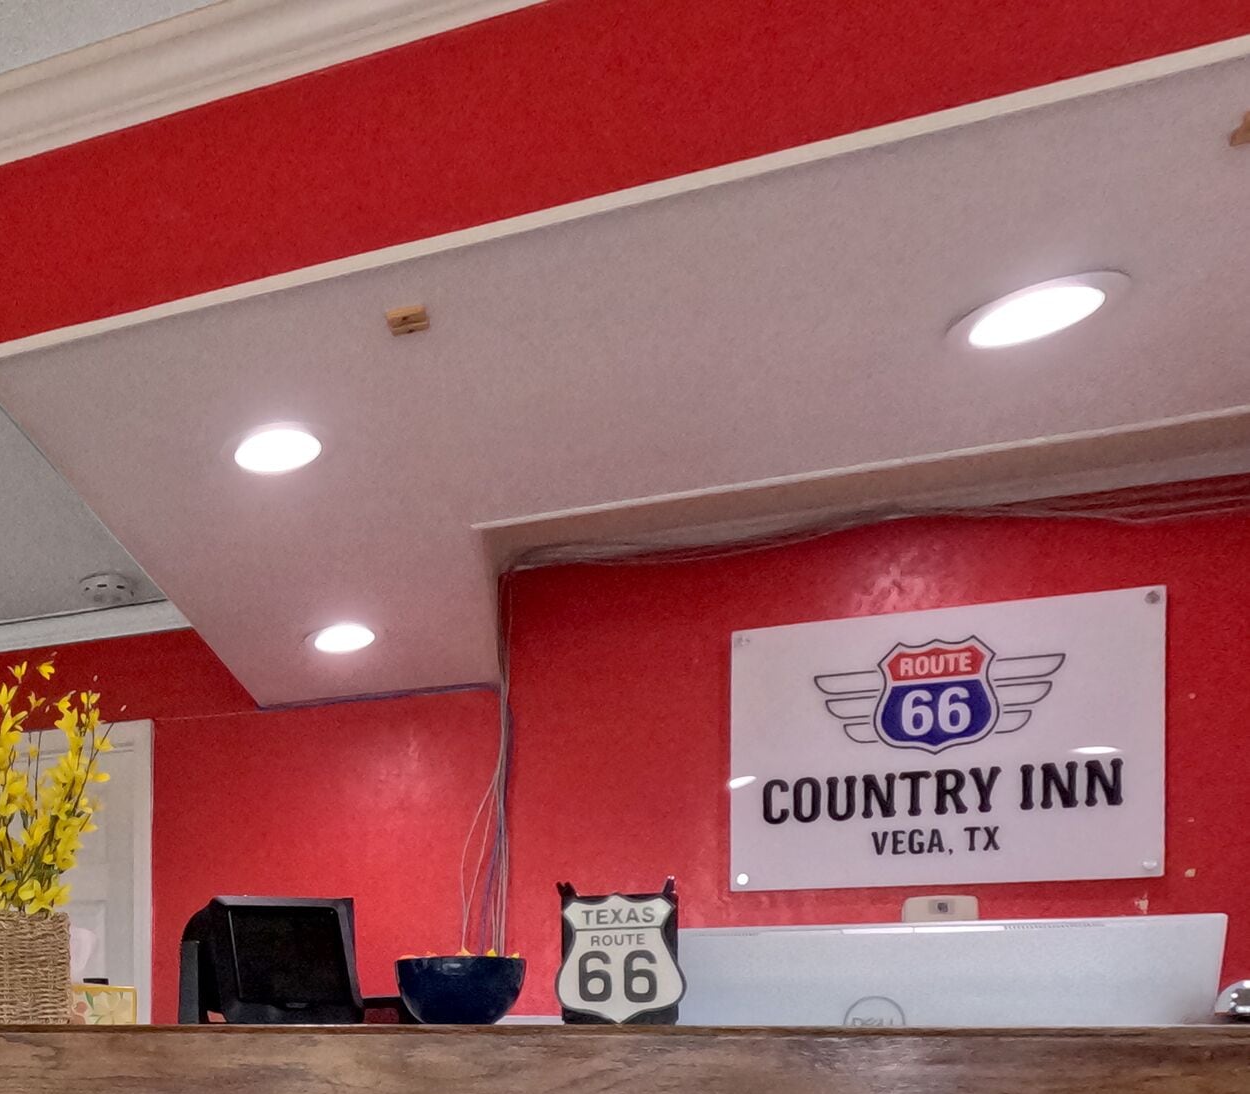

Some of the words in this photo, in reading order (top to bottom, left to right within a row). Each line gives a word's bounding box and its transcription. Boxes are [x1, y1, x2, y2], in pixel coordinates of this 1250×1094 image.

[899, 652, 972, 676] ROUTE
[901, 686, 971, 737] 66
[762, 766, 1002, 825] COUNTRY
[1019, 758, 1124, 810] INN
[871, 827, 954, 856] VEGA,
[964, 826, 1001, 852] TX
[582, 907, 655, 925] TEXAS
[590, 933, 646, 946] ROUTE
[578, 949, 658, 1003] 66
